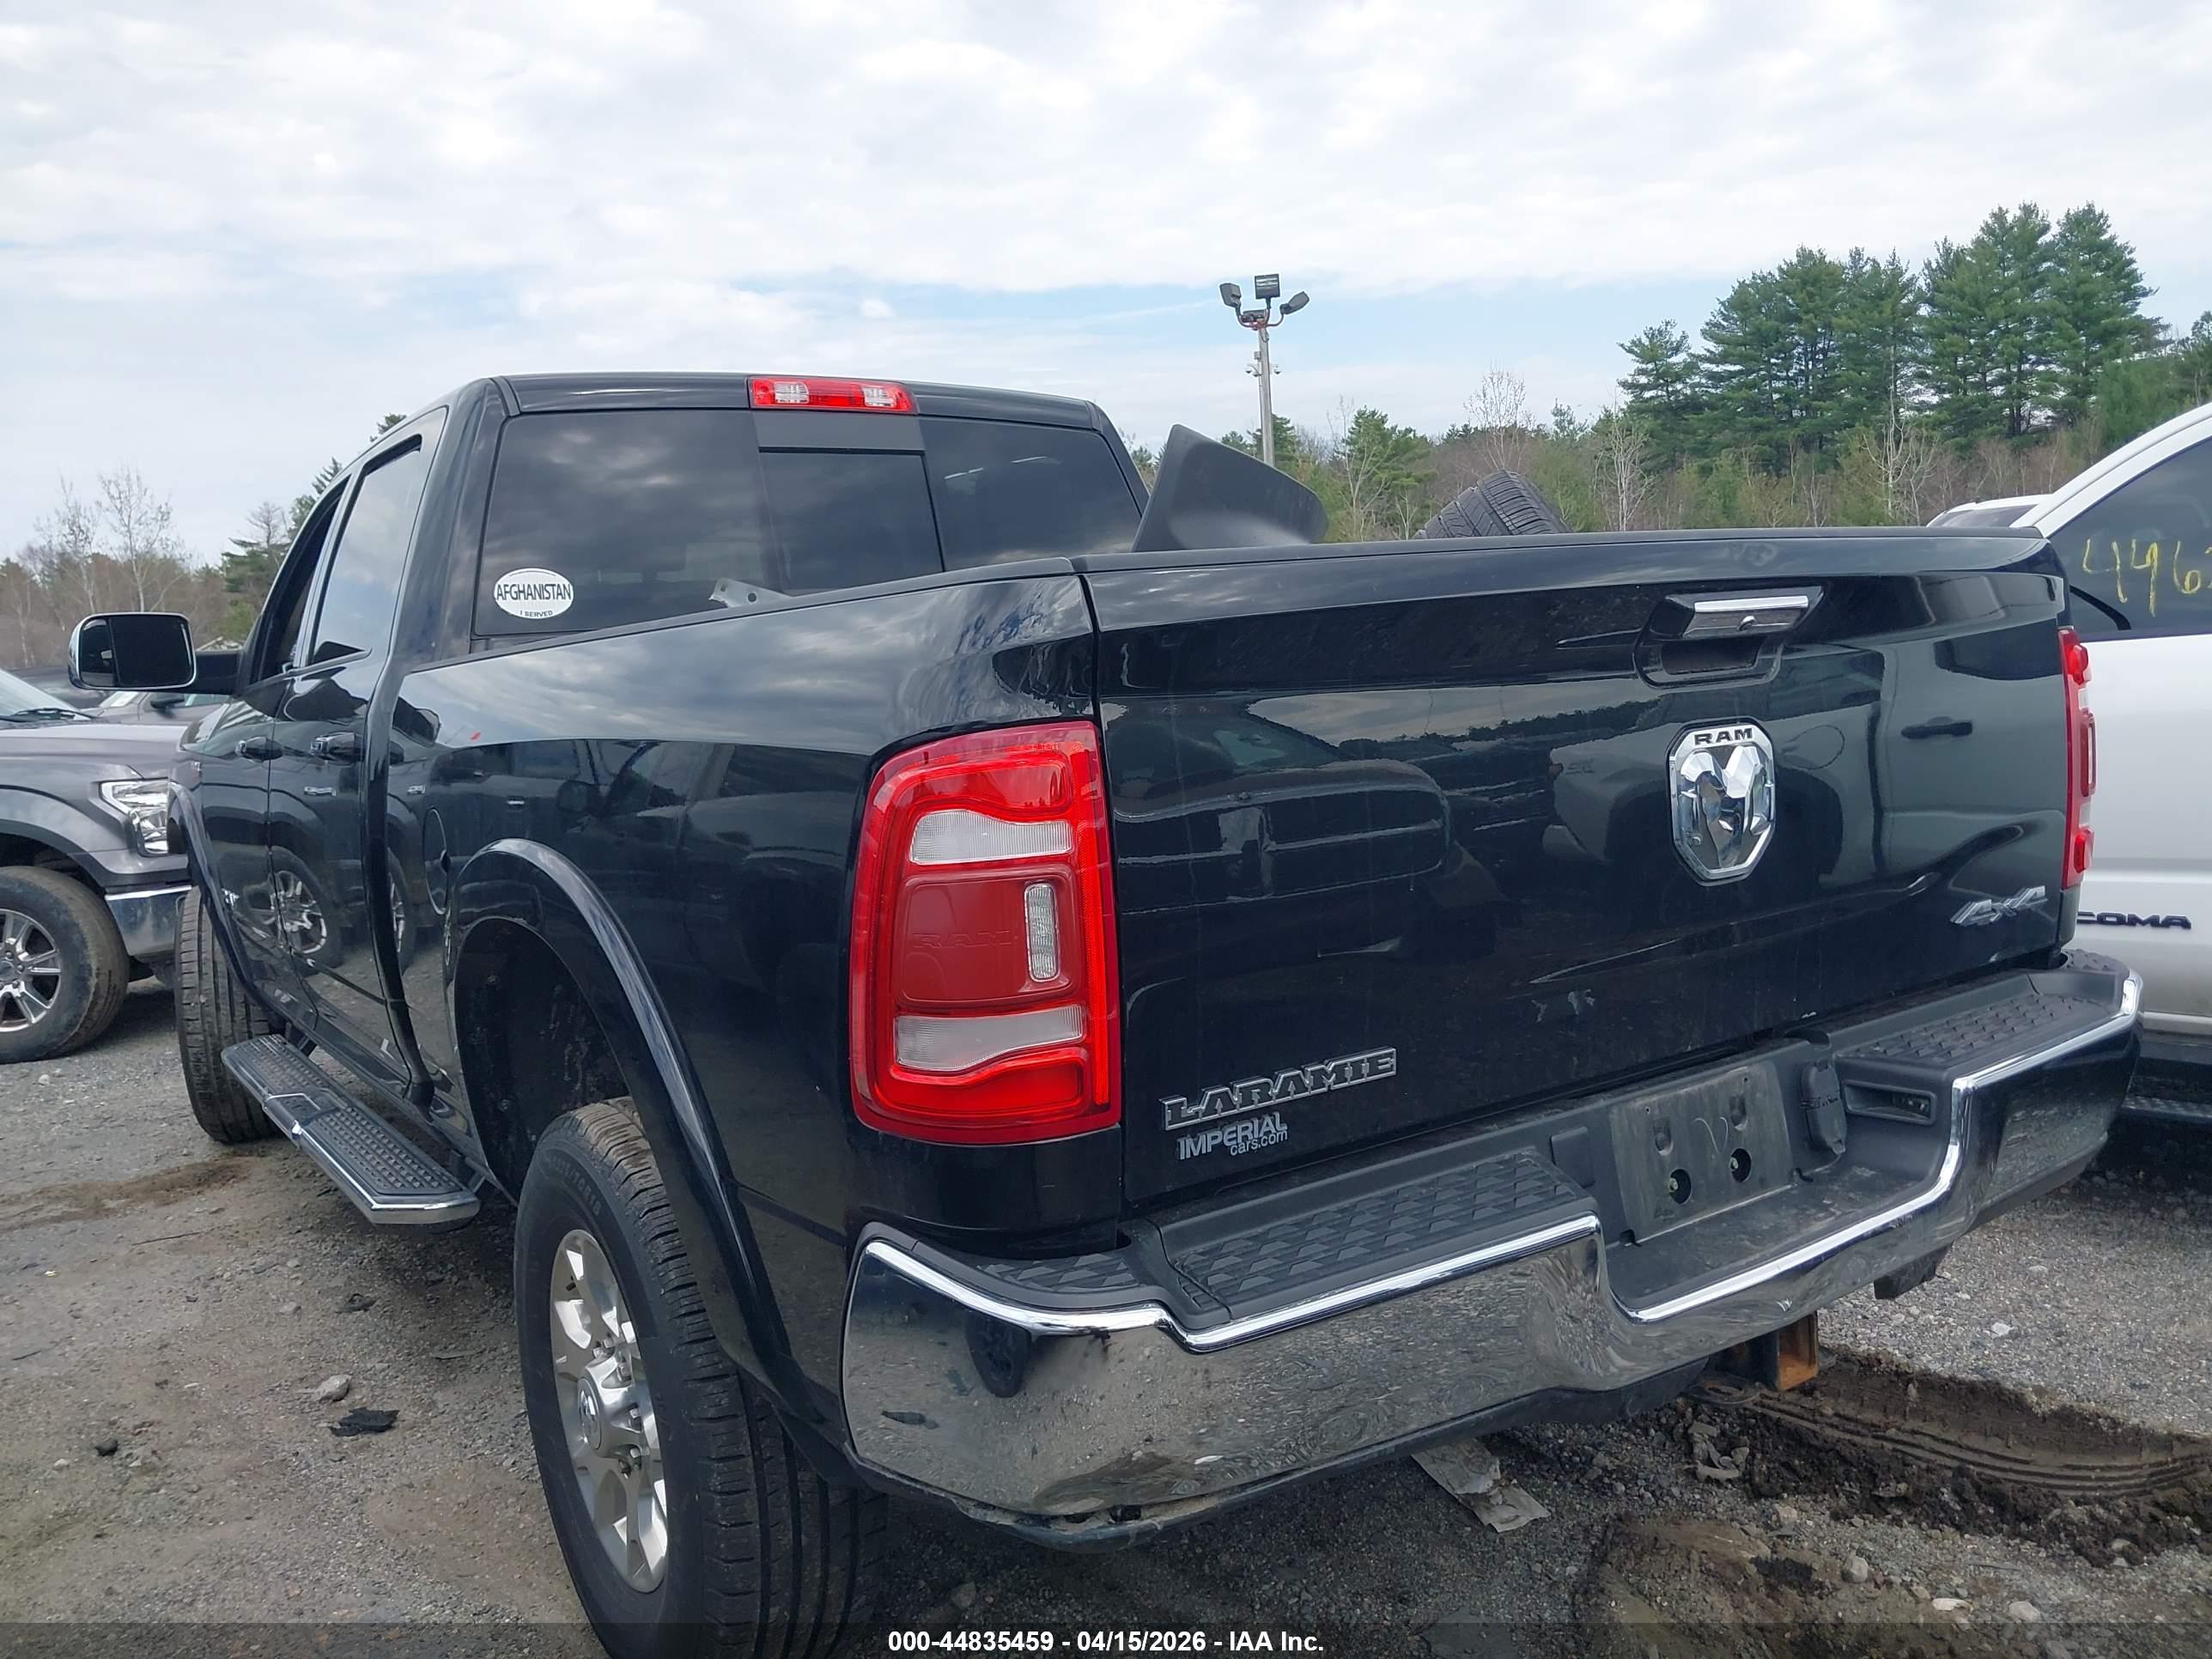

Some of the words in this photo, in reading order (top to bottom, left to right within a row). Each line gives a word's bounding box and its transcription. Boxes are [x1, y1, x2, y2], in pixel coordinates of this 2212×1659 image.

[495, 583, 573, 601] AFGHANISTAN
[1693, 727, 1753, 747] RAM
[913, 929, 1013, 949] RAM
[1159, 1046, 1397, 1132] LARAMIE
[1177, 1110, 1288, 1160] IMPERIAL
[1230, 1129, 1288, 1157] cars.com
